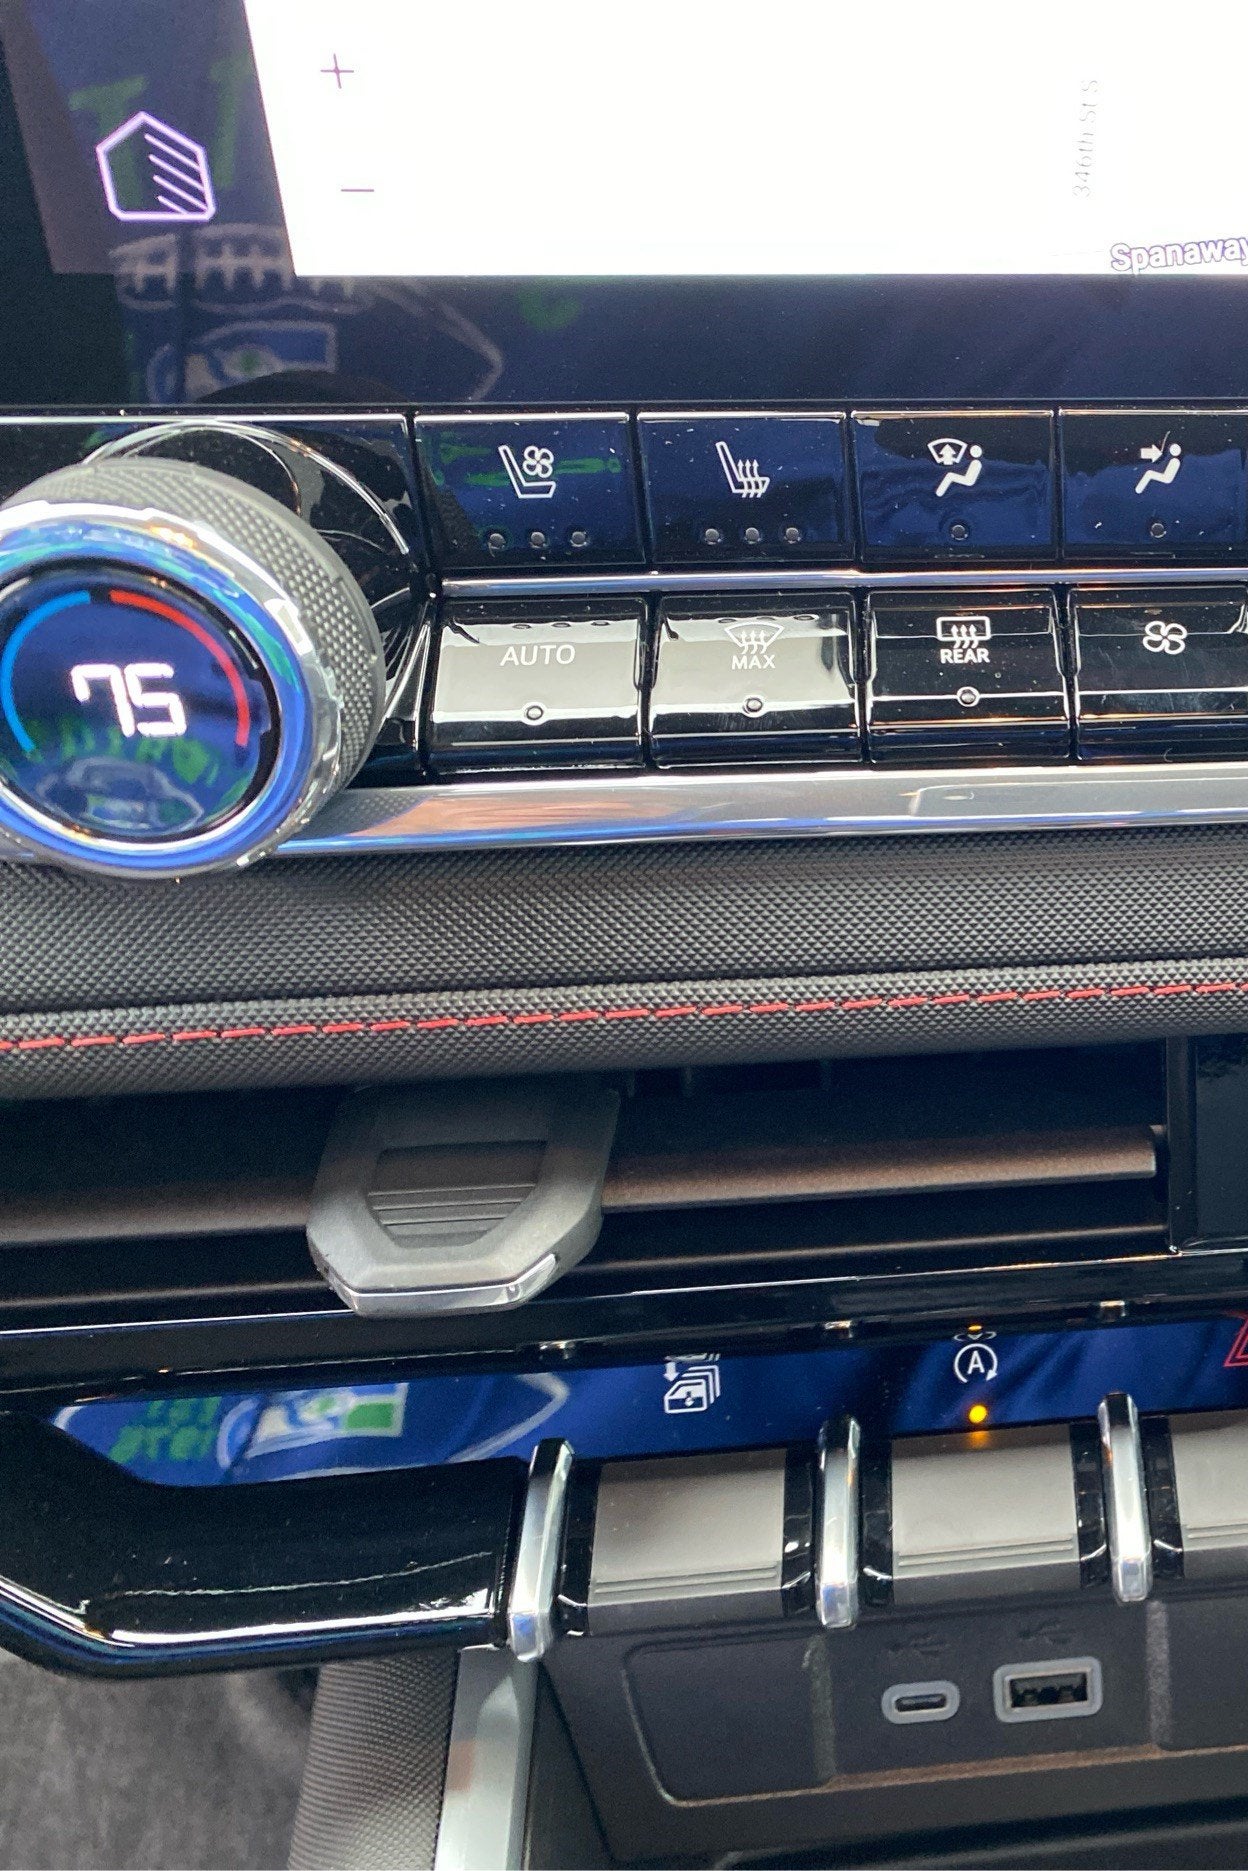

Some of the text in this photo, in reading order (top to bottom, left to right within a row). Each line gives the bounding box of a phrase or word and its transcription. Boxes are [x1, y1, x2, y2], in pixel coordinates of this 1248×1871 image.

[499, 643, 577, 668] AUTO
[731, 653, 775, 671] MAX
[939, 648, 990, 666] REAR
[71, 662, 188, 738] 75
